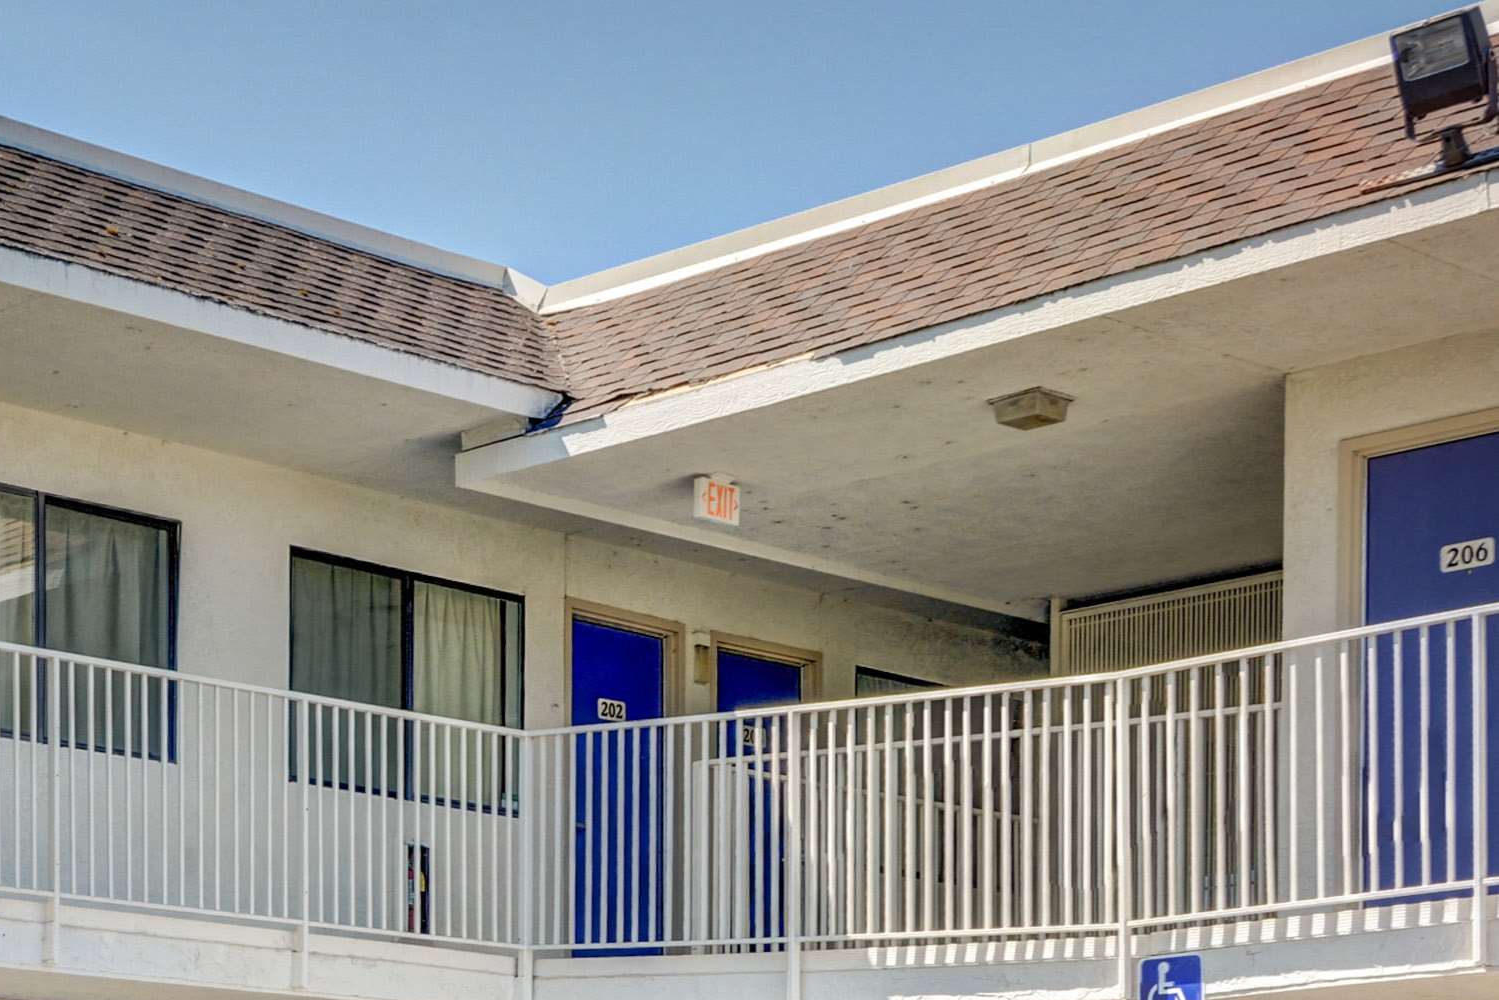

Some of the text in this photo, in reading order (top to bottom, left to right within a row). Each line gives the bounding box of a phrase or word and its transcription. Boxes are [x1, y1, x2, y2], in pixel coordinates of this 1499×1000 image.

[708, 482, 735, 520] EXIT
[1446, 542, 1488, 568] 206
[601, 701, 623, 719] 202
